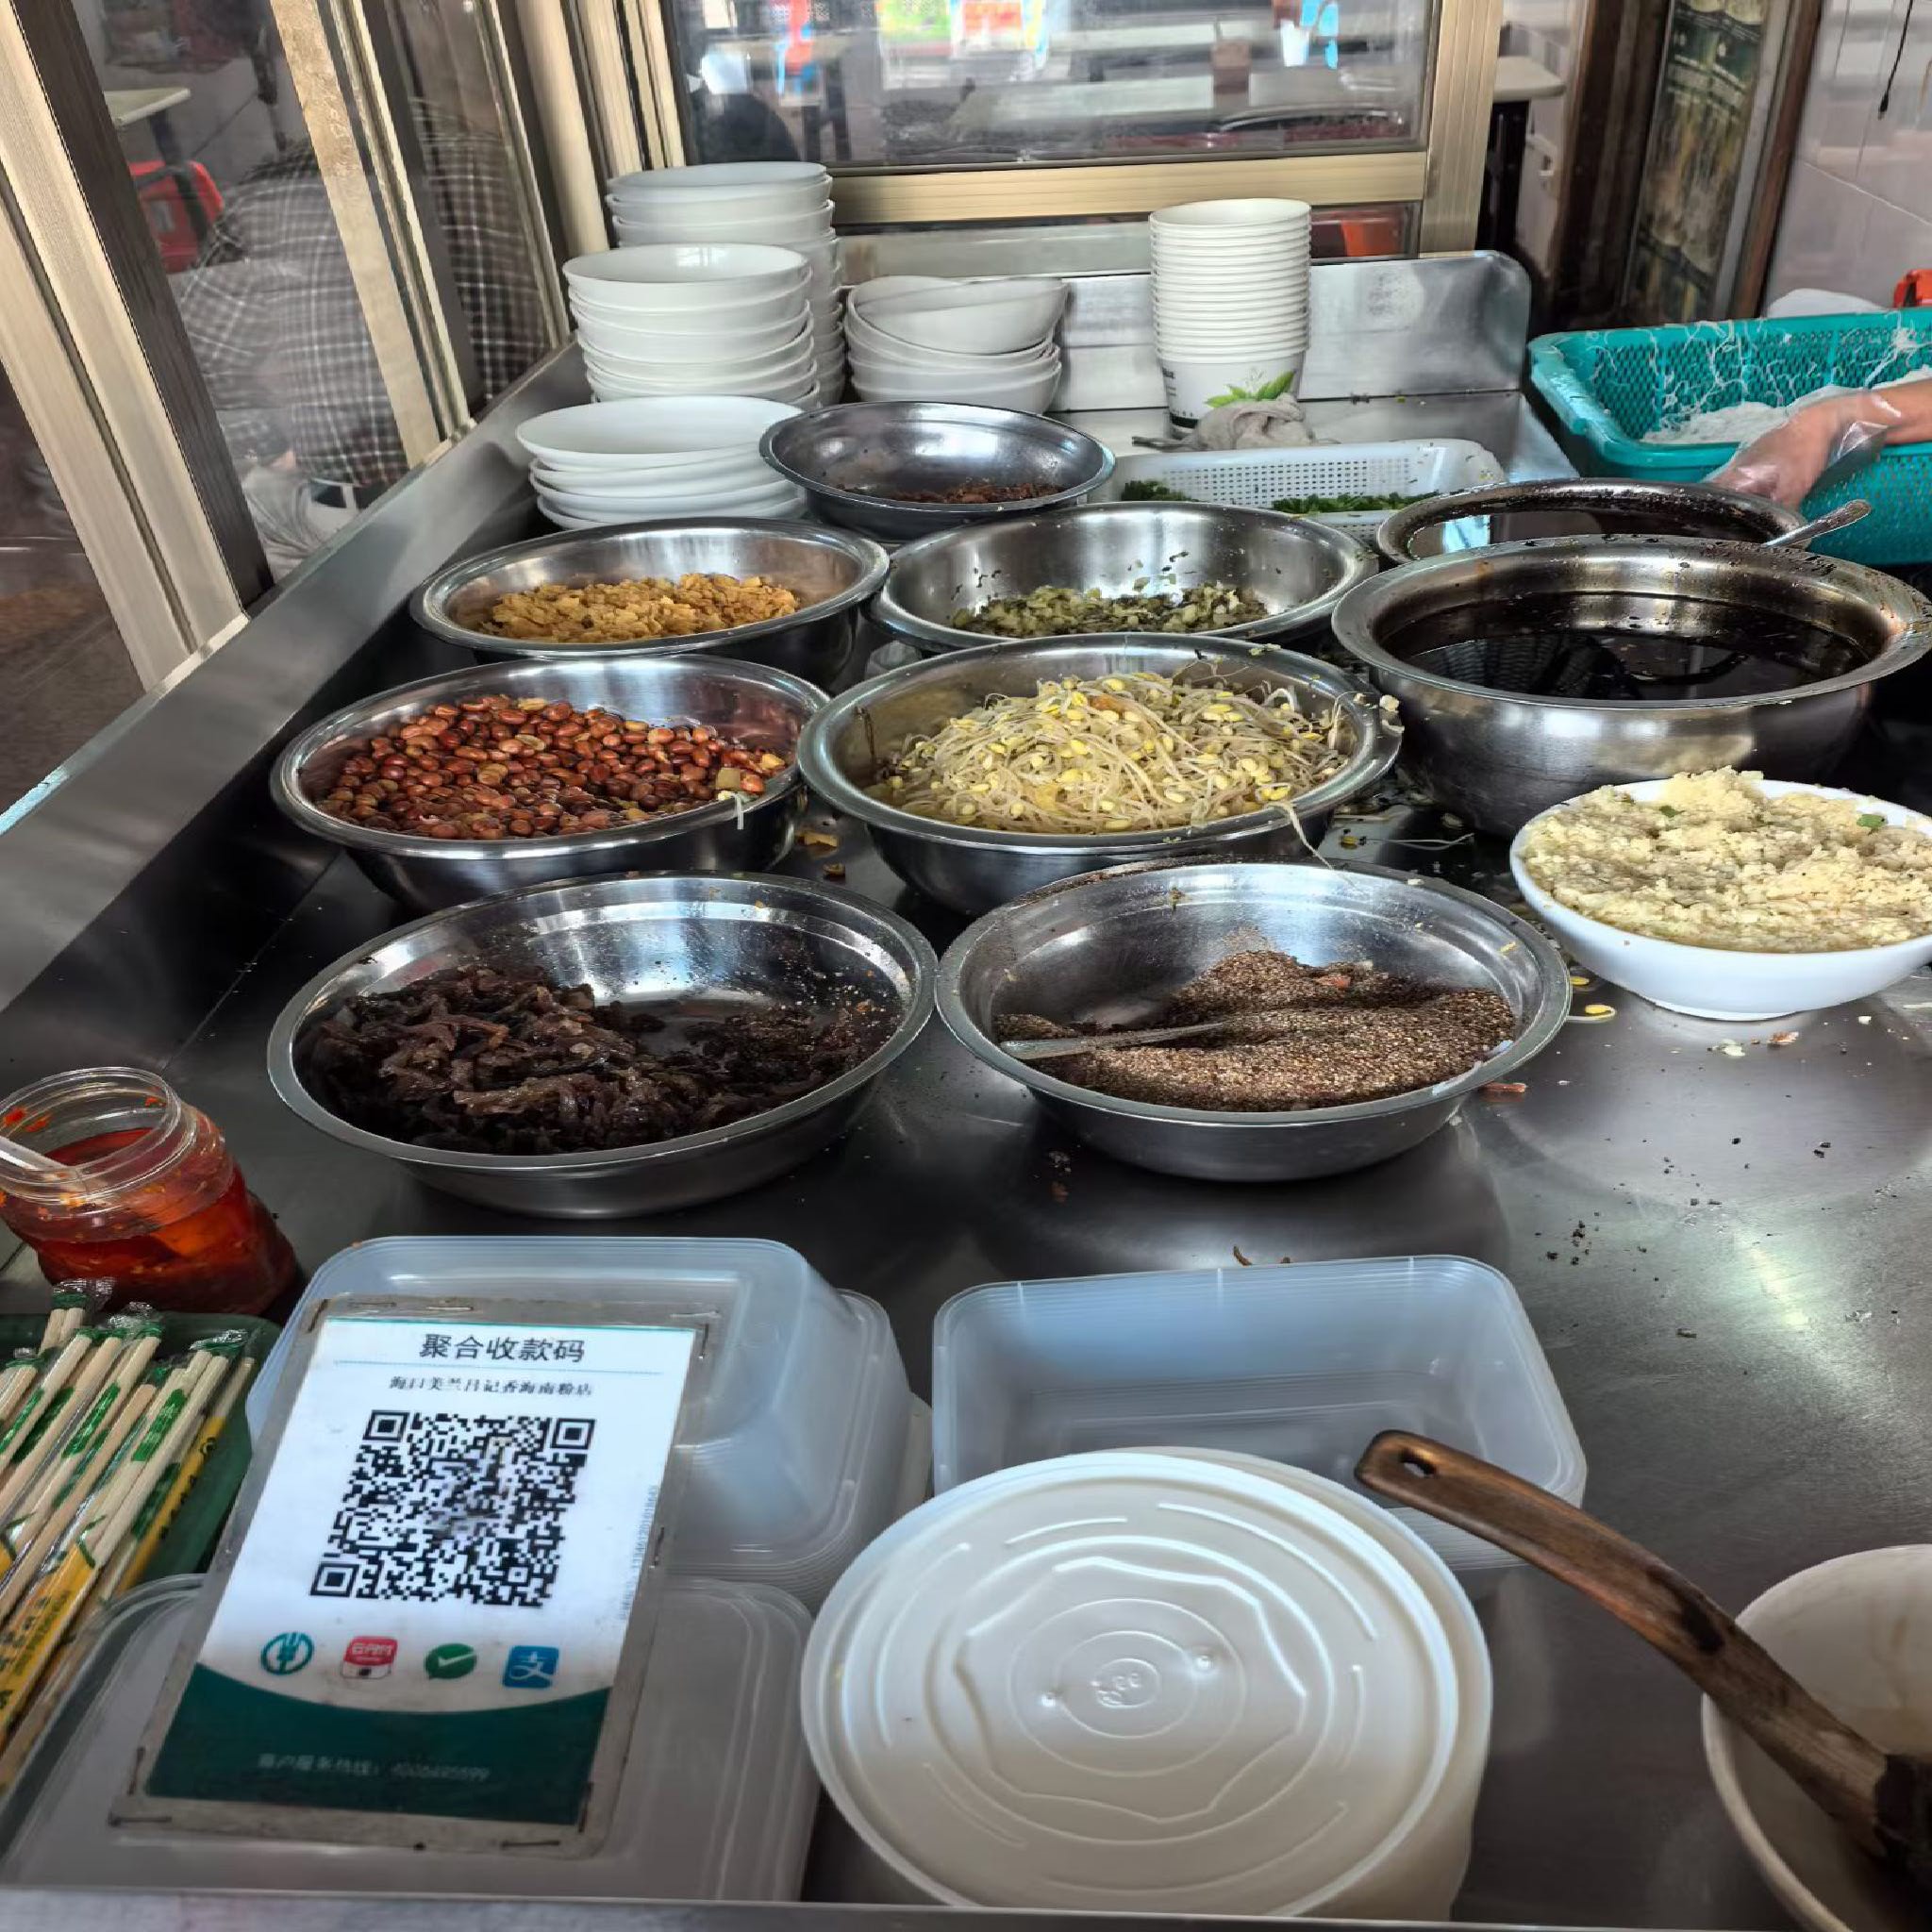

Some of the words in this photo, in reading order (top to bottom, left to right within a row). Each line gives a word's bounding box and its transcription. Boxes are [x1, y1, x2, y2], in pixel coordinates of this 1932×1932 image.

[419, 1333, 586, 1363] 聚合收款码
